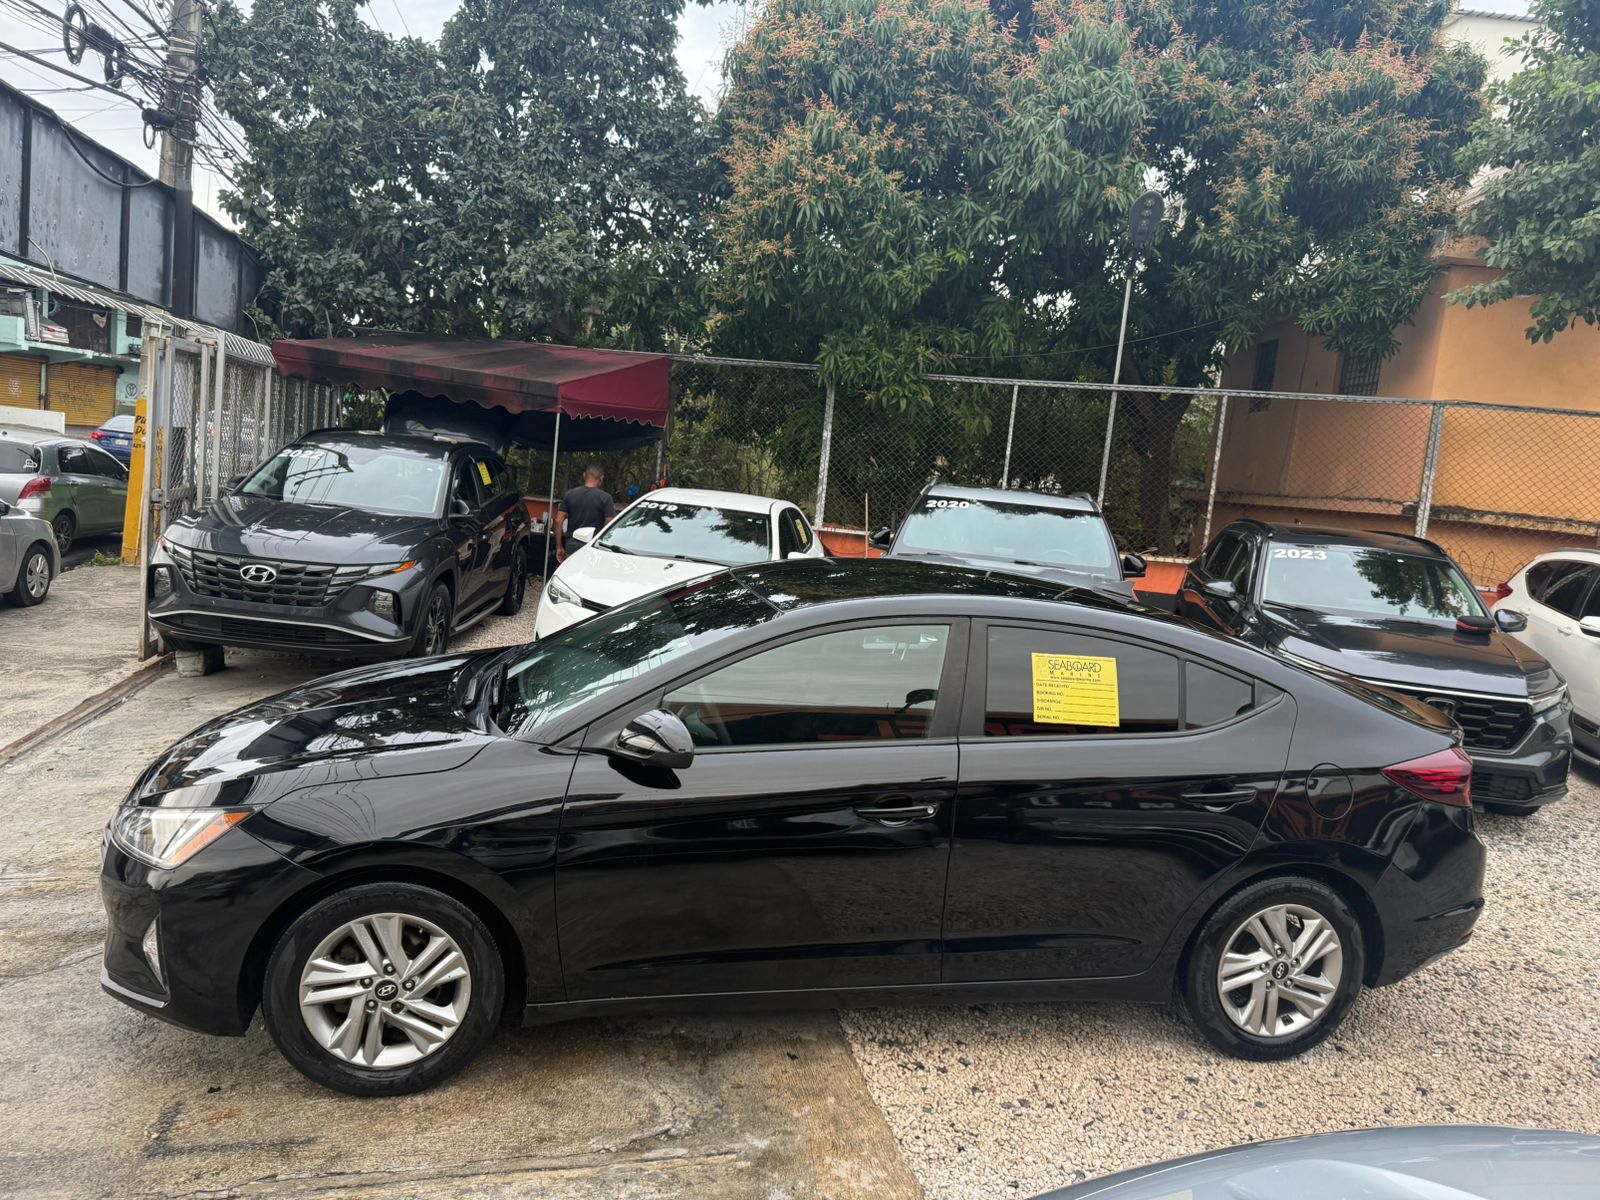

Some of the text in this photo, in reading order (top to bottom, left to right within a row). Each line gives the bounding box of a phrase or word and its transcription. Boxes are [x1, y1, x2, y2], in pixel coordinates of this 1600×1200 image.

[277, 448, 326, 459] 2022
[637, 502, 678, 511] 2019
[925, 499, 970, 509] 2020
[1274, 549, 1327, 560] 2023
[1049, 660, 1101, 673] SEABOARD
